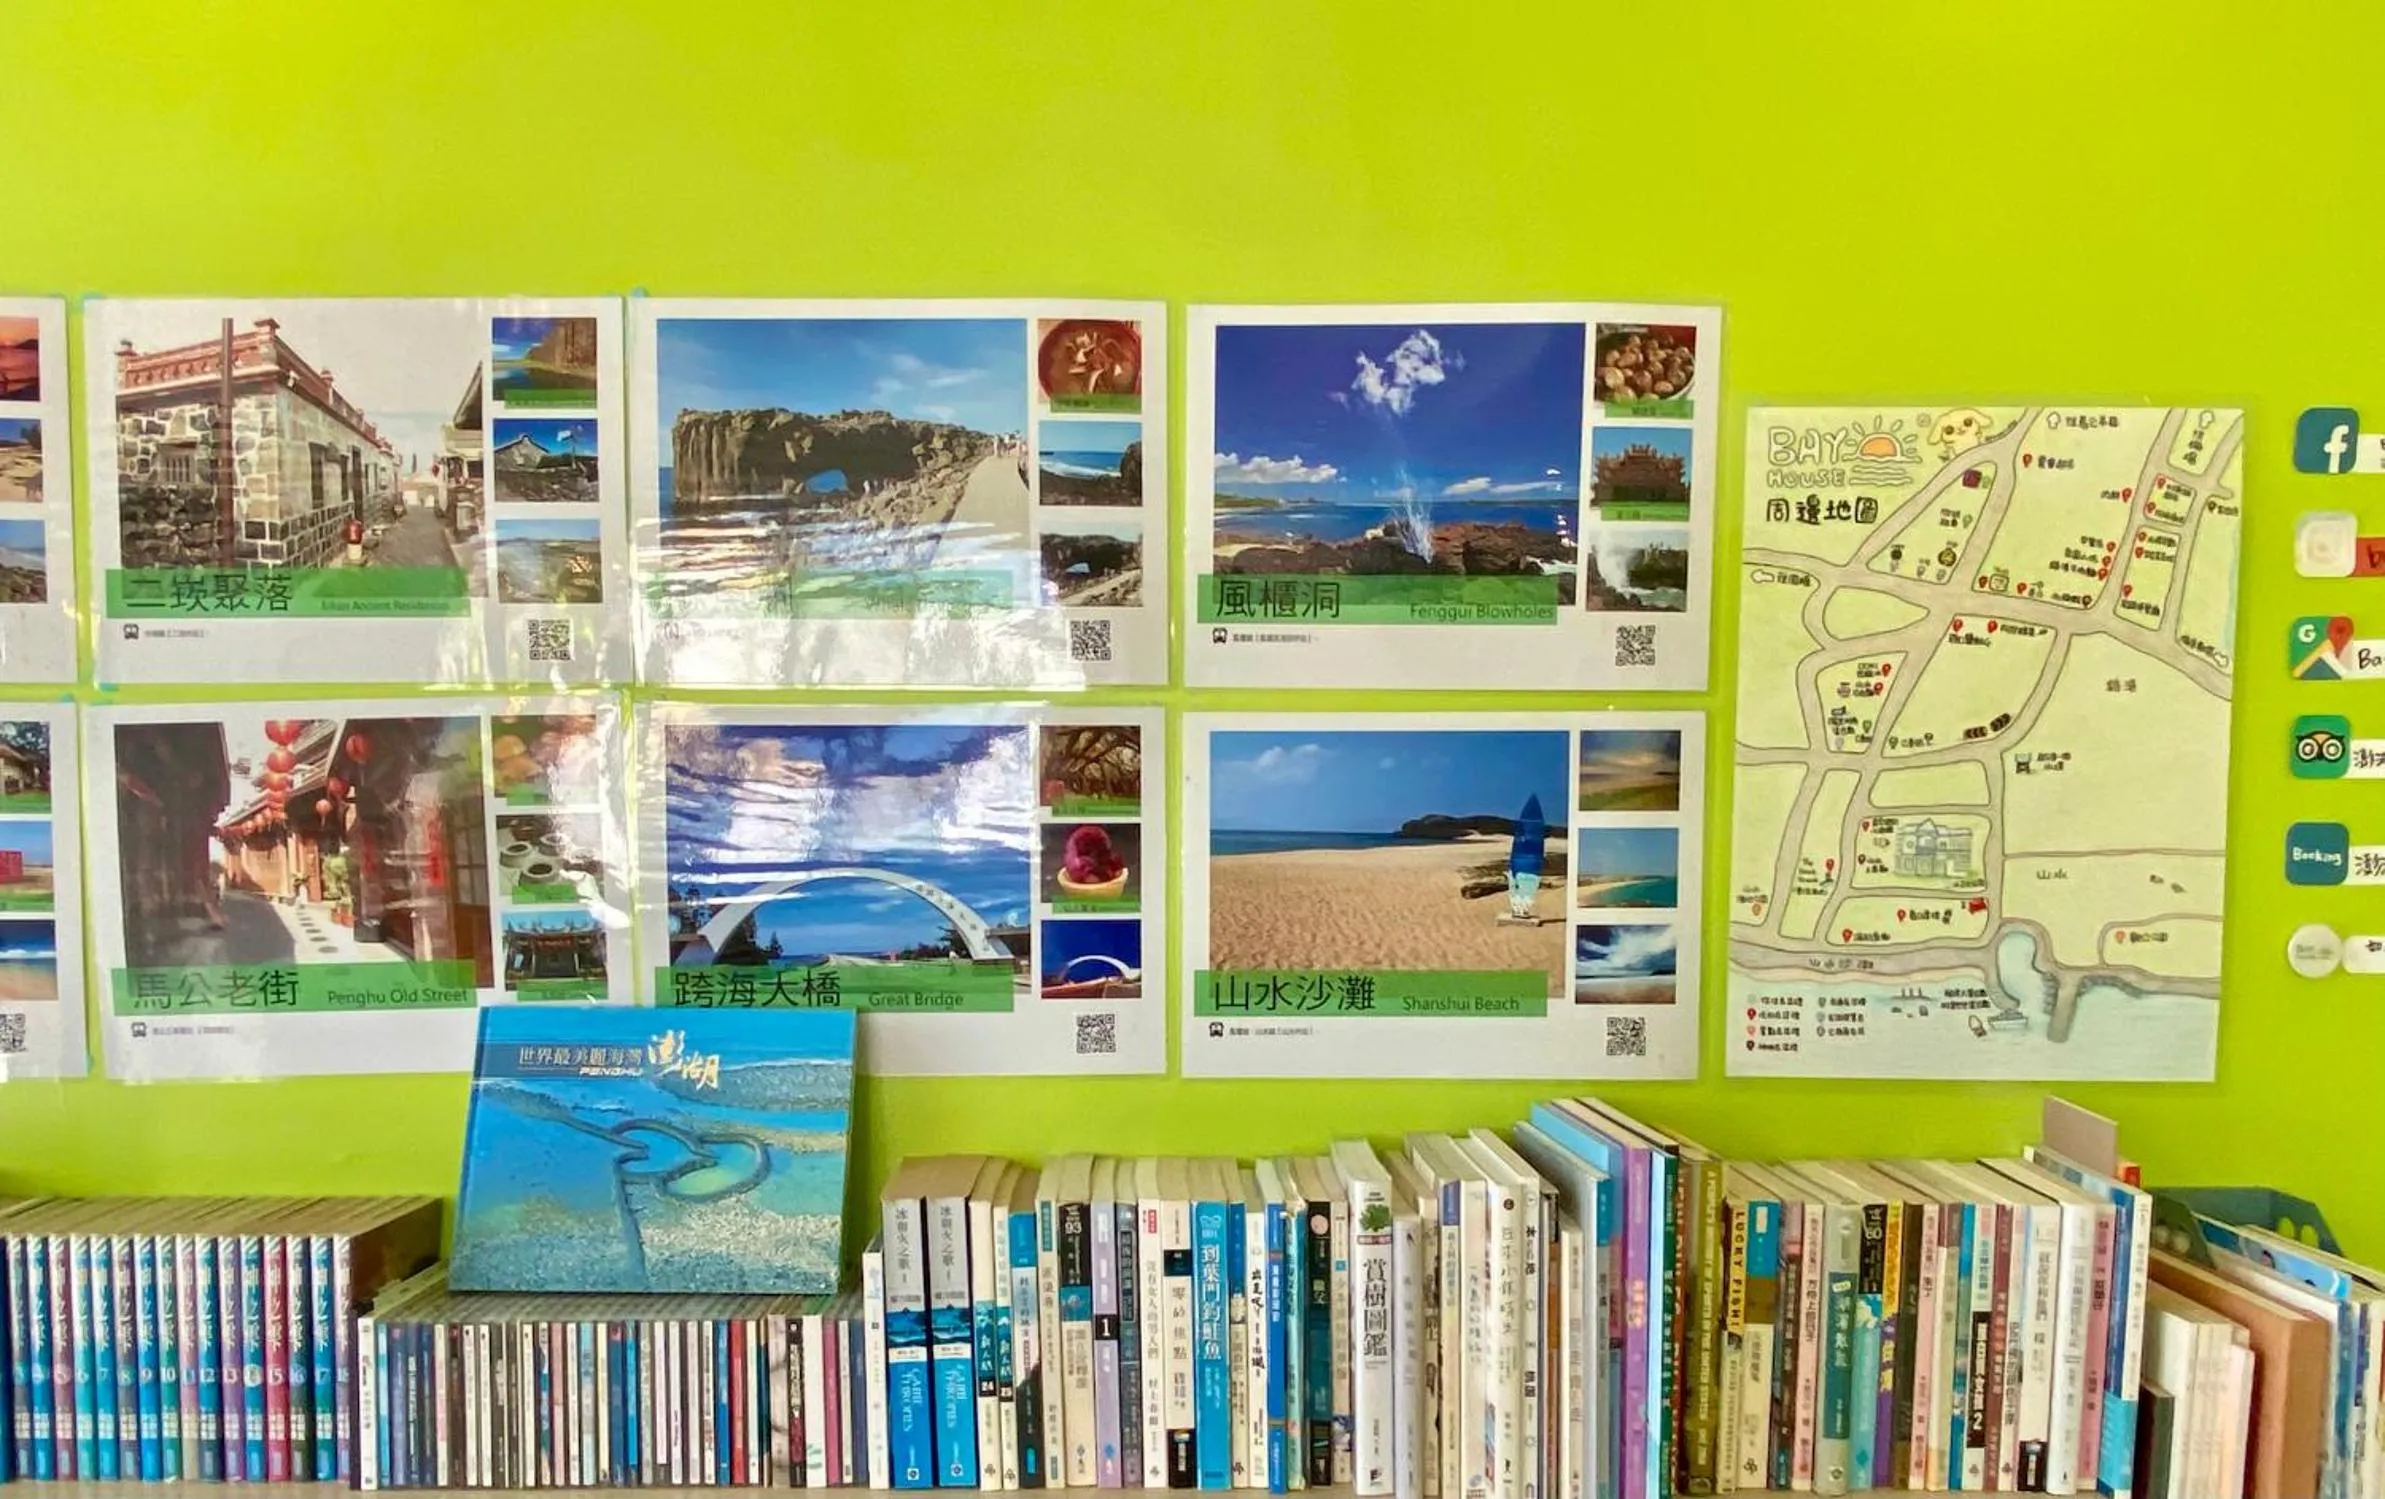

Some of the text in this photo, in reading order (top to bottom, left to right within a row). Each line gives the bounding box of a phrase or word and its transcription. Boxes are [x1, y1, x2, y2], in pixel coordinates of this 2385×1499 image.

[1767, 426, 1848, 466] BAY
[1766, 468, 1846, 488] HOUSE
[1766, 494, 1879, 525] 周邊地圖
[126, 573, 294, 613] 二崁聚落
[1216, 578, 1341, 619] 風櫃洞
[1410, 603, 1555, 621] Fenggui Blowholes
[134, 969, 300, 1010] 馬公老街
[328, 988, 468, 1008] Penghu Old Street
[673, 970, 841, 1008] 跨海大橋
[868, 991, 964, 1010] Great Bridge
[1214, 974, 1378, 1012] 山水沙灘
[1403, 995, 1521, 1011] Shanshui Beach
[579, 1066, 644, 1078] PENGHU
[1065, 1221, 1082, 1234] 93
[1733, 1212, 1746, 1269] LUCKY
[1362, 1258, 1389, 1357] 賞樹圖鑑
[1102, 1319, 1110, 1337] 1
[1972, 1412, 1984, 1430] 2
